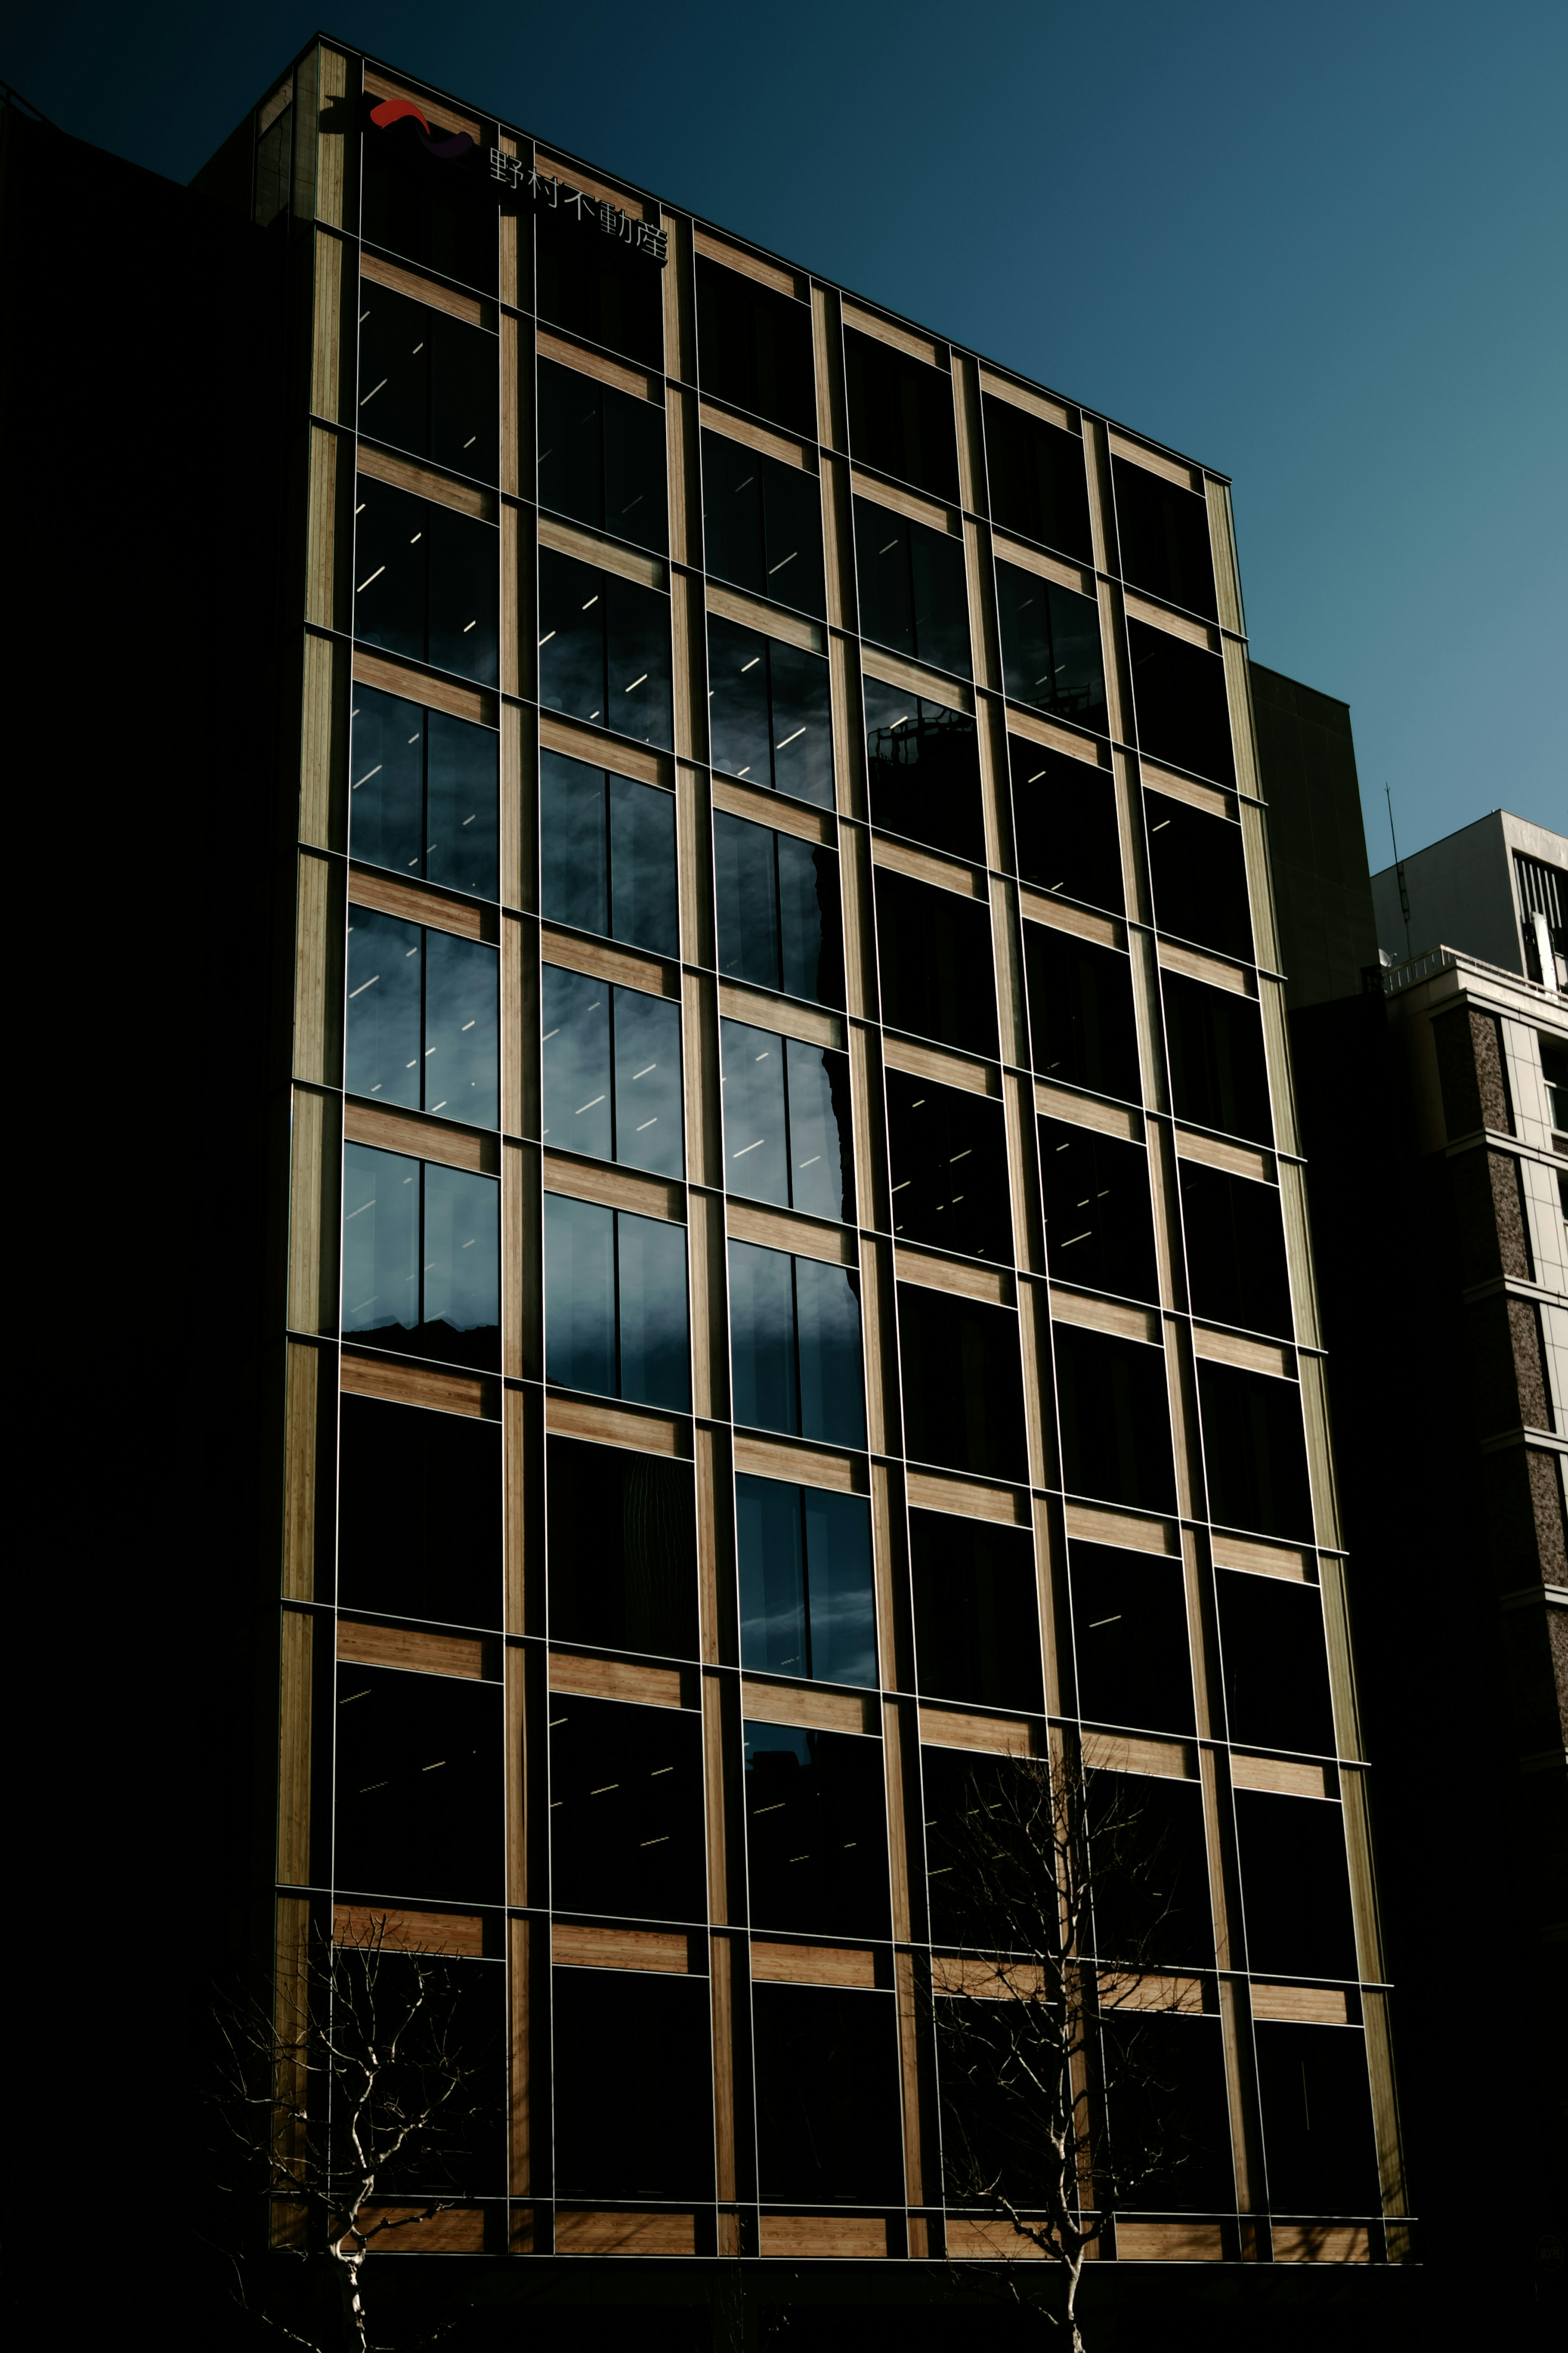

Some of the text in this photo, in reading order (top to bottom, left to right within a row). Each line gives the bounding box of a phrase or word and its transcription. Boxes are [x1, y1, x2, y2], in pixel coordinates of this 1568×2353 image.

[490, 147, 668, 262] 野村不動産
